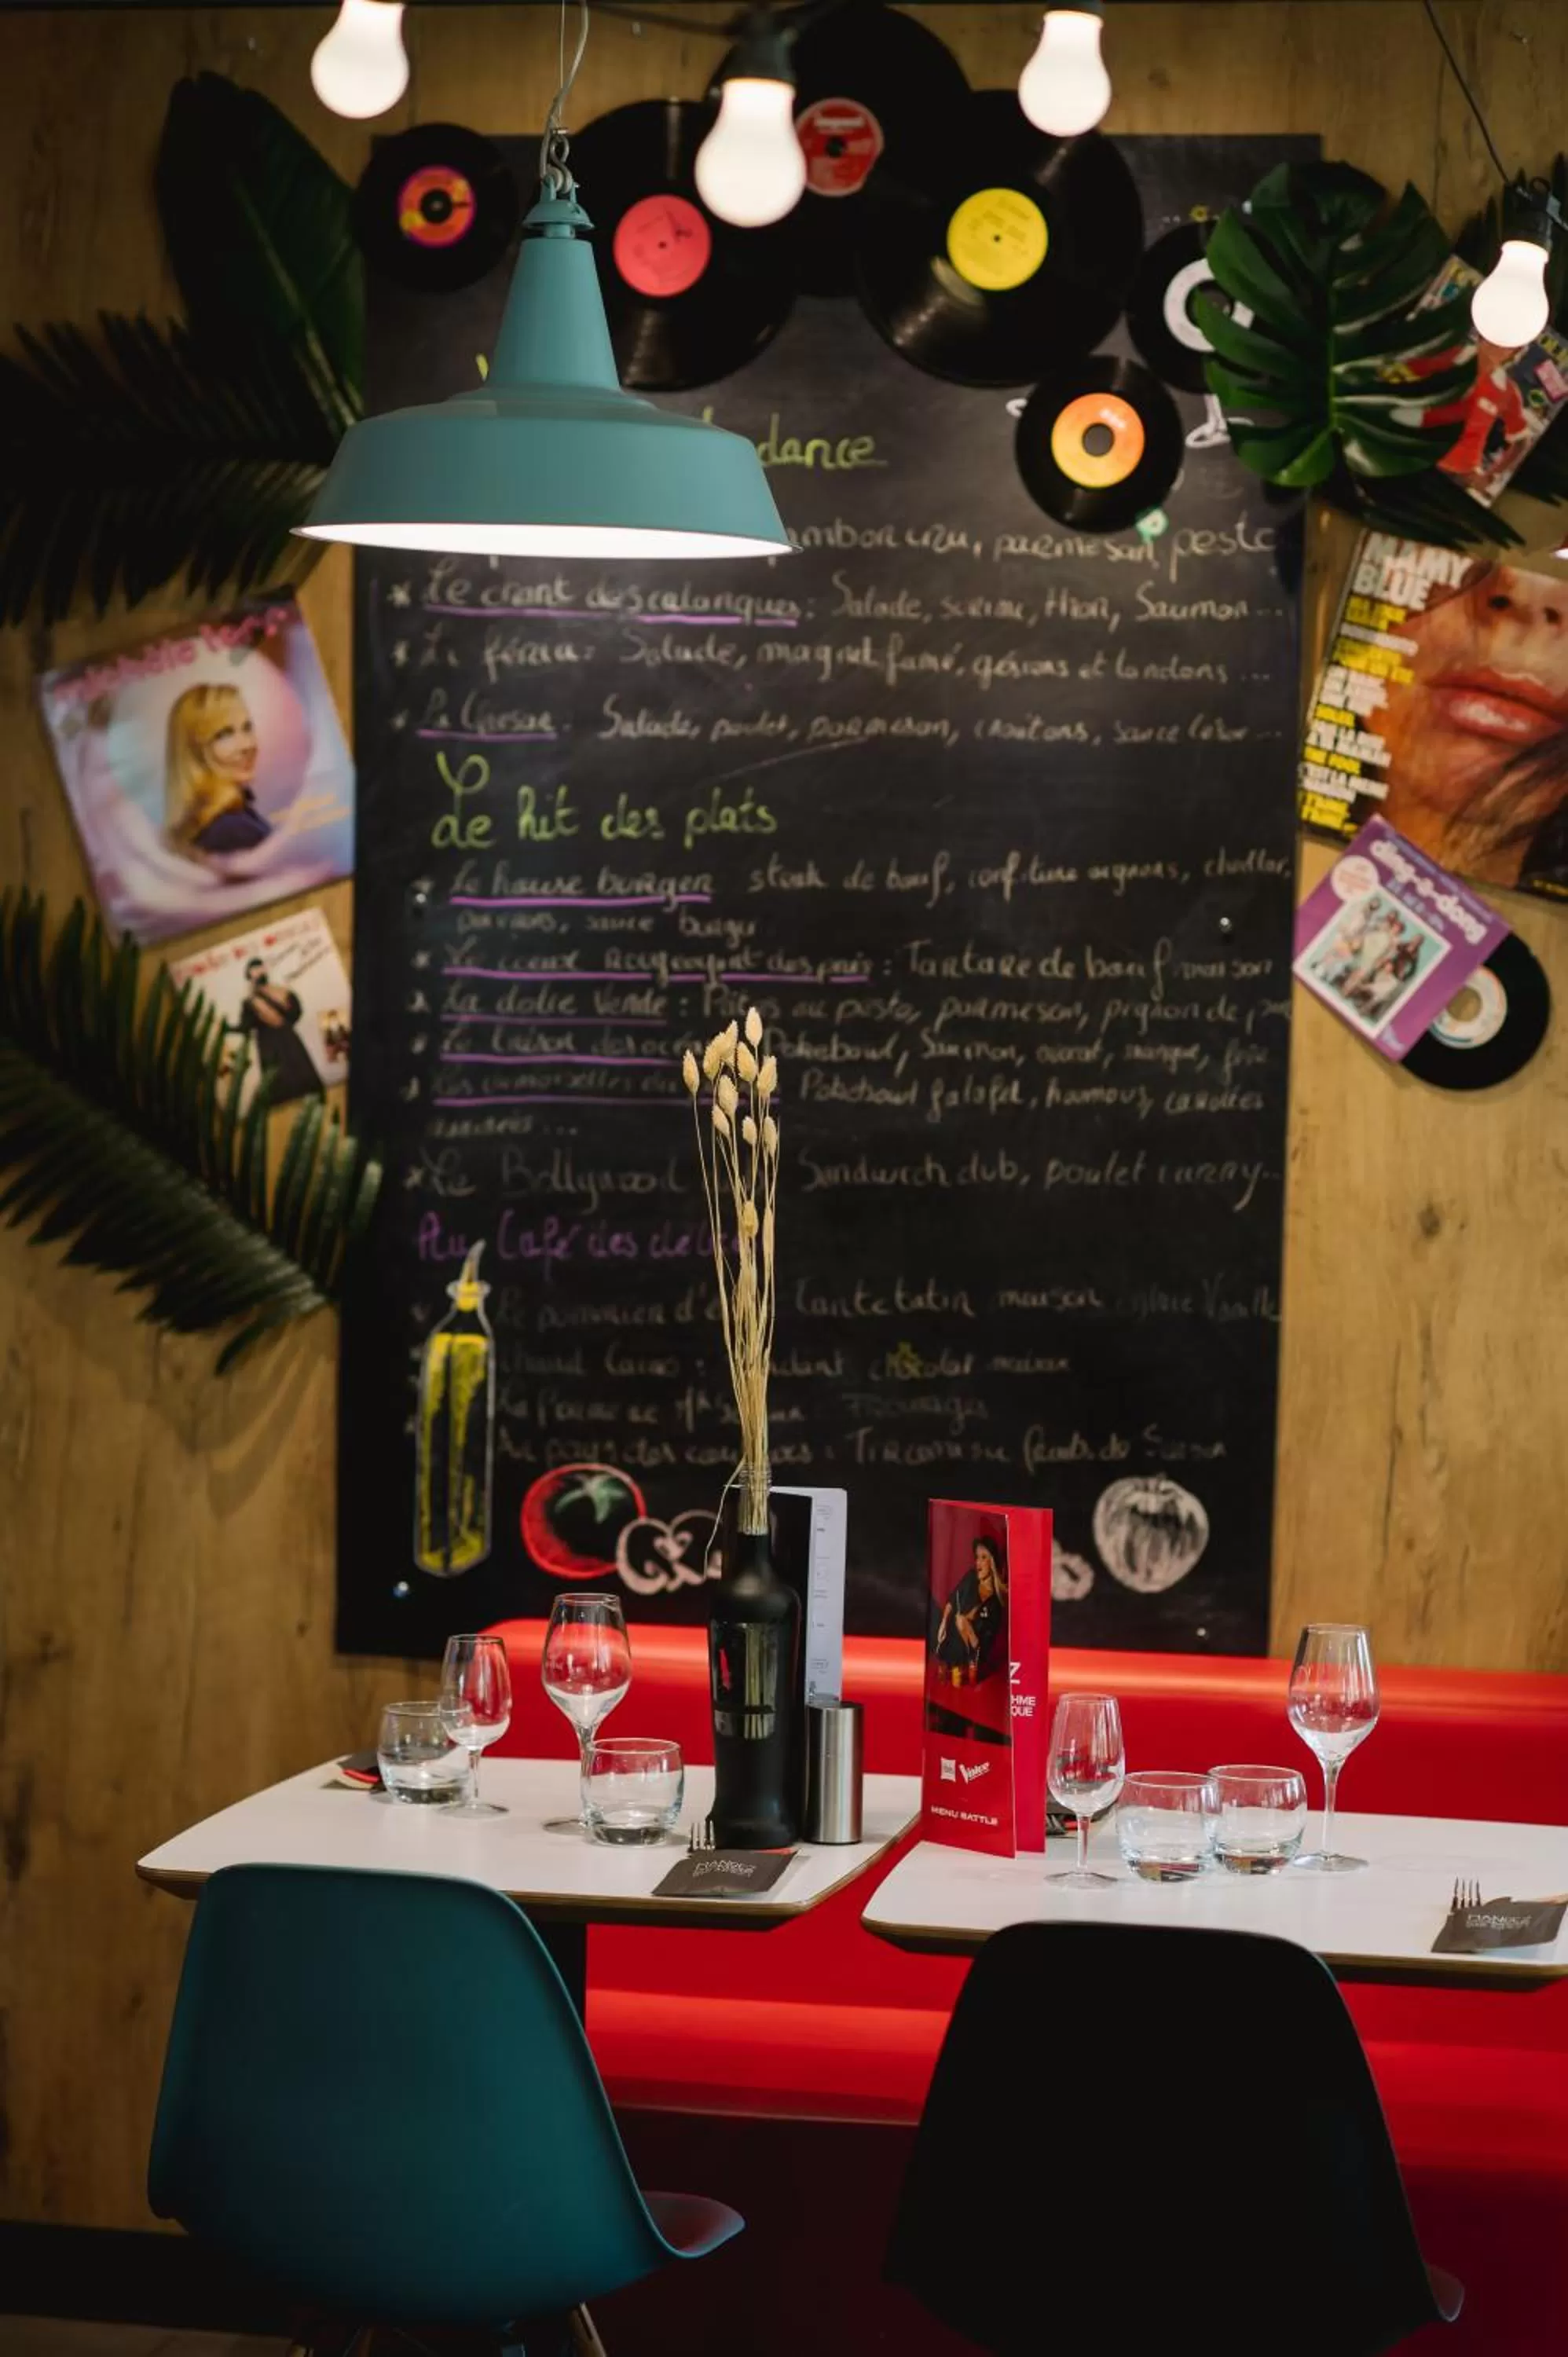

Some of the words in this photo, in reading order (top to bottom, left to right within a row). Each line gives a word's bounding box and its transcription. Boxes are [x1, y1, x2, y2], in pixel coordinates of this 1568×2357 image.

[756, 411, 889, 471] dance
[1353, 560, 1431, 612] BLUE
[595, 693, 701, 739] Salade,
[599, 792, 665, 841] des
[683, 786, 779, 849] plats
[842, 858, 877, 892] de
[1010, 1695, 1036, 1706] HME
[959, 1811, 999, 1827] BATTLE
